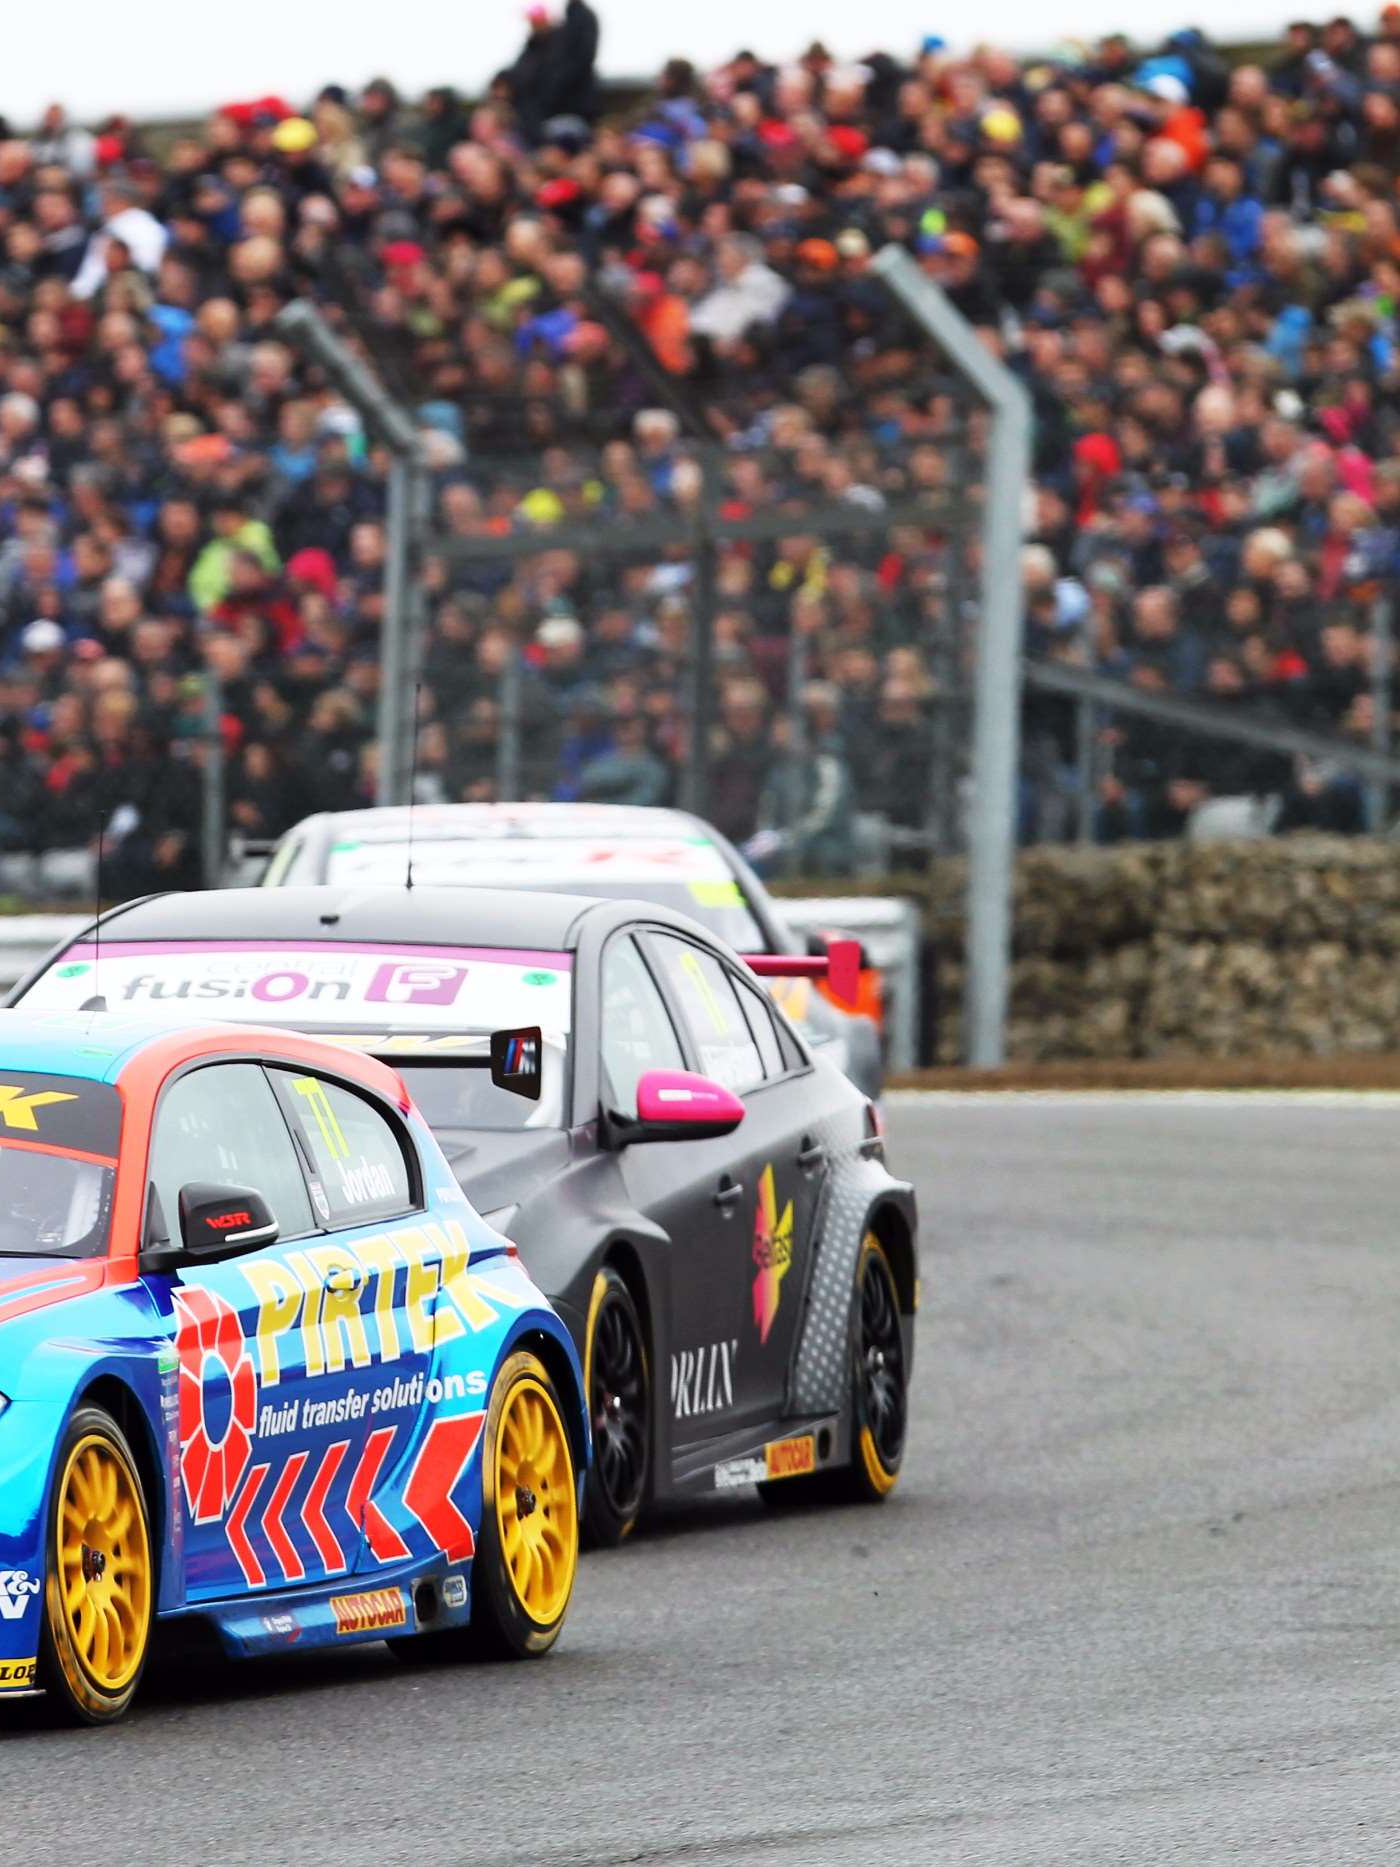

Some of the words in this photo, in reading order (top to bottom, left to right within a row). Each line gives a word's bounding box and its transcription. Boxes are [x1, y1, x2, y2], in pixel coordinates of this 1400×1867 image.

[292, 1077, 350, 1161] 77
[336, 1155, 396, 1205] Jordan
[238, 1219, 523, 1389] PIRTEK
[258, 1400, 298, 1438] fluid
[302, 1388, 367, 1421] transfer
[371, 1370, 488, 1411] solutions
[333, 1588, 405, 1632] AUTOCAR
